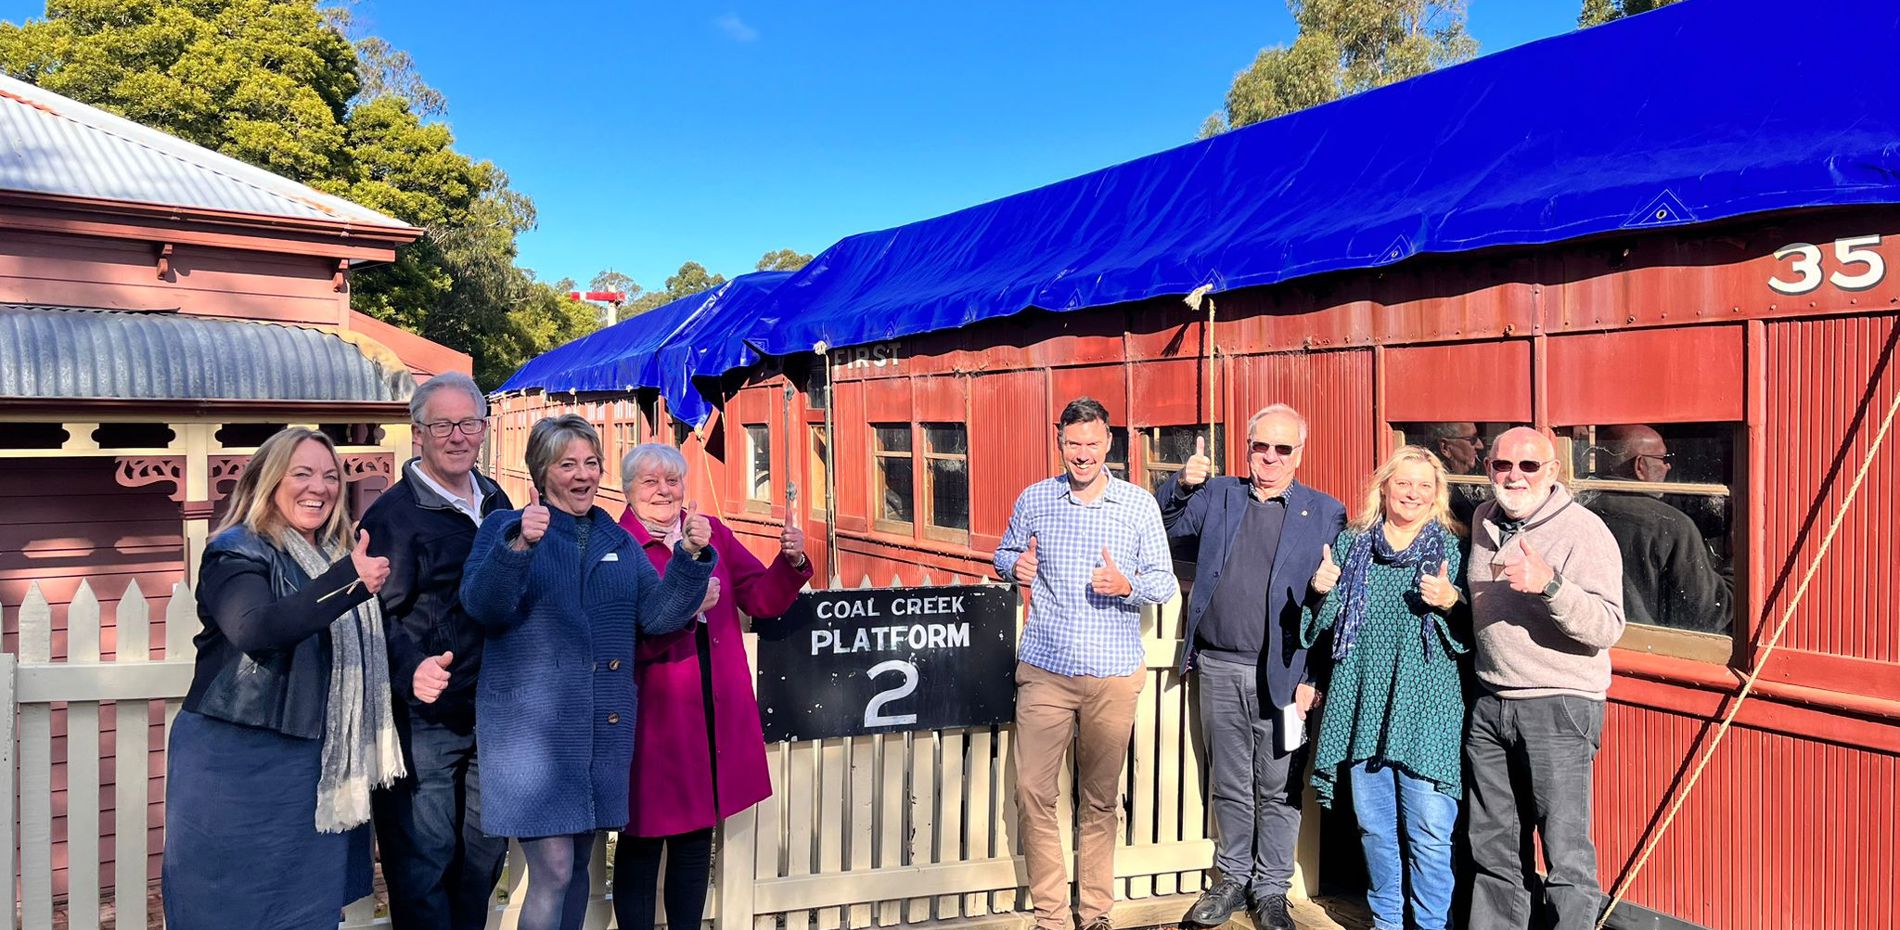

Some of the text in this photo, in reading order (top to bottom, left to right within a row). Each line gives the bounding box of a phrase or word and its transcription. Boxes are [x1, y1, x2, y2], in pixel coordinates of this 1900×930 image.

[1768, 234, 1886, 295] 35
[834, 342, 901, 370] FIRST
[816, 596, 965, 619] COAL CREEK
[811, 622, 970, 655] PLATFORM
[864, 659, 919, 727] 2
